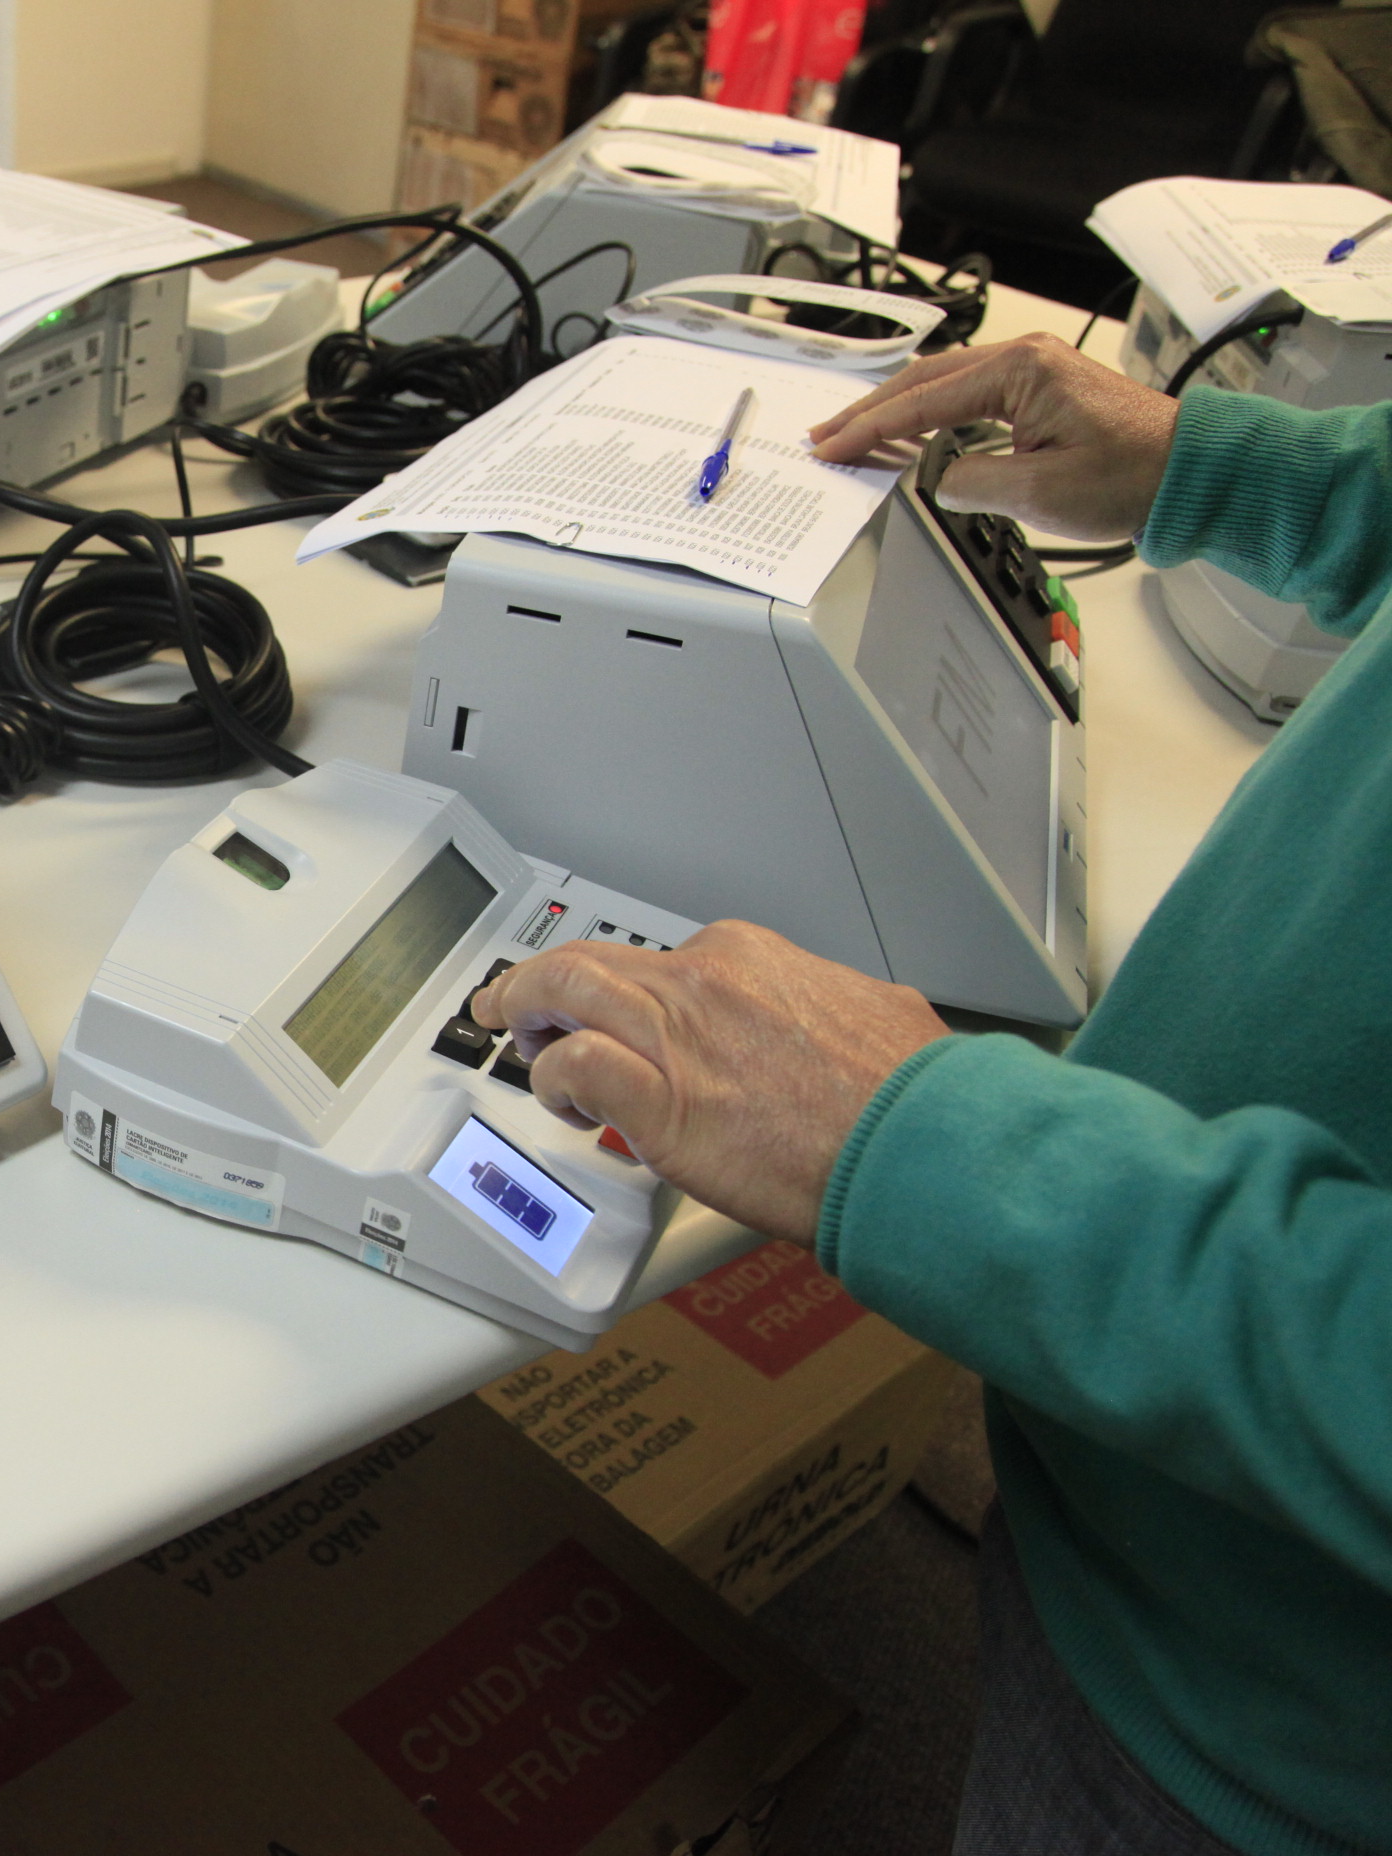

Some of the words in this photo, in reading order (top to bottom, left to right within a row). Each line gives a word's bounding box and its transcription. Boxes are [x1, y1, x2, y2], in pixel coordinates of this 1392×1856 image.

[932, 620, 998, 799] FIM
[525, 911, 555, 947] SEGURANÇA
[455, 1026, 476, 1040] 1
[126, 1128, 144, 1141] LACRE
[144, 1135, 179, 1157] DISPOSITIVO
[180, 1150, 189, 1159] DE
[126, 1134, 148, 1150] CARTÃO
[148, 1144, 185, 1164] INTELIGENTE
[692, 1240, 807, 1317] CUIDAD
[747, 1275, 841, 1342] FRÁG
[499, 1364, 554, 1403] NÃO
[616, 1348, 638, 1366] A
[538, 1359, 675, 1450] ELETRÔNICA
[563, 1431, 620, 1470] ORA
[612, 1410, 653, 1440] DA
[588, 1415, 698, 1494] BALAGEM
[211, 1420, 437, 1582] TRANSPORTAR
[724, 1443, 842, 1553] URNA
[307, 1507, 382, 1568] NÃO
[180, 1567, 214, 1600] A
[398, 1585, 623, 1775] CUIDADO
[478, 1667, 675, 1826] FRÁGIL
